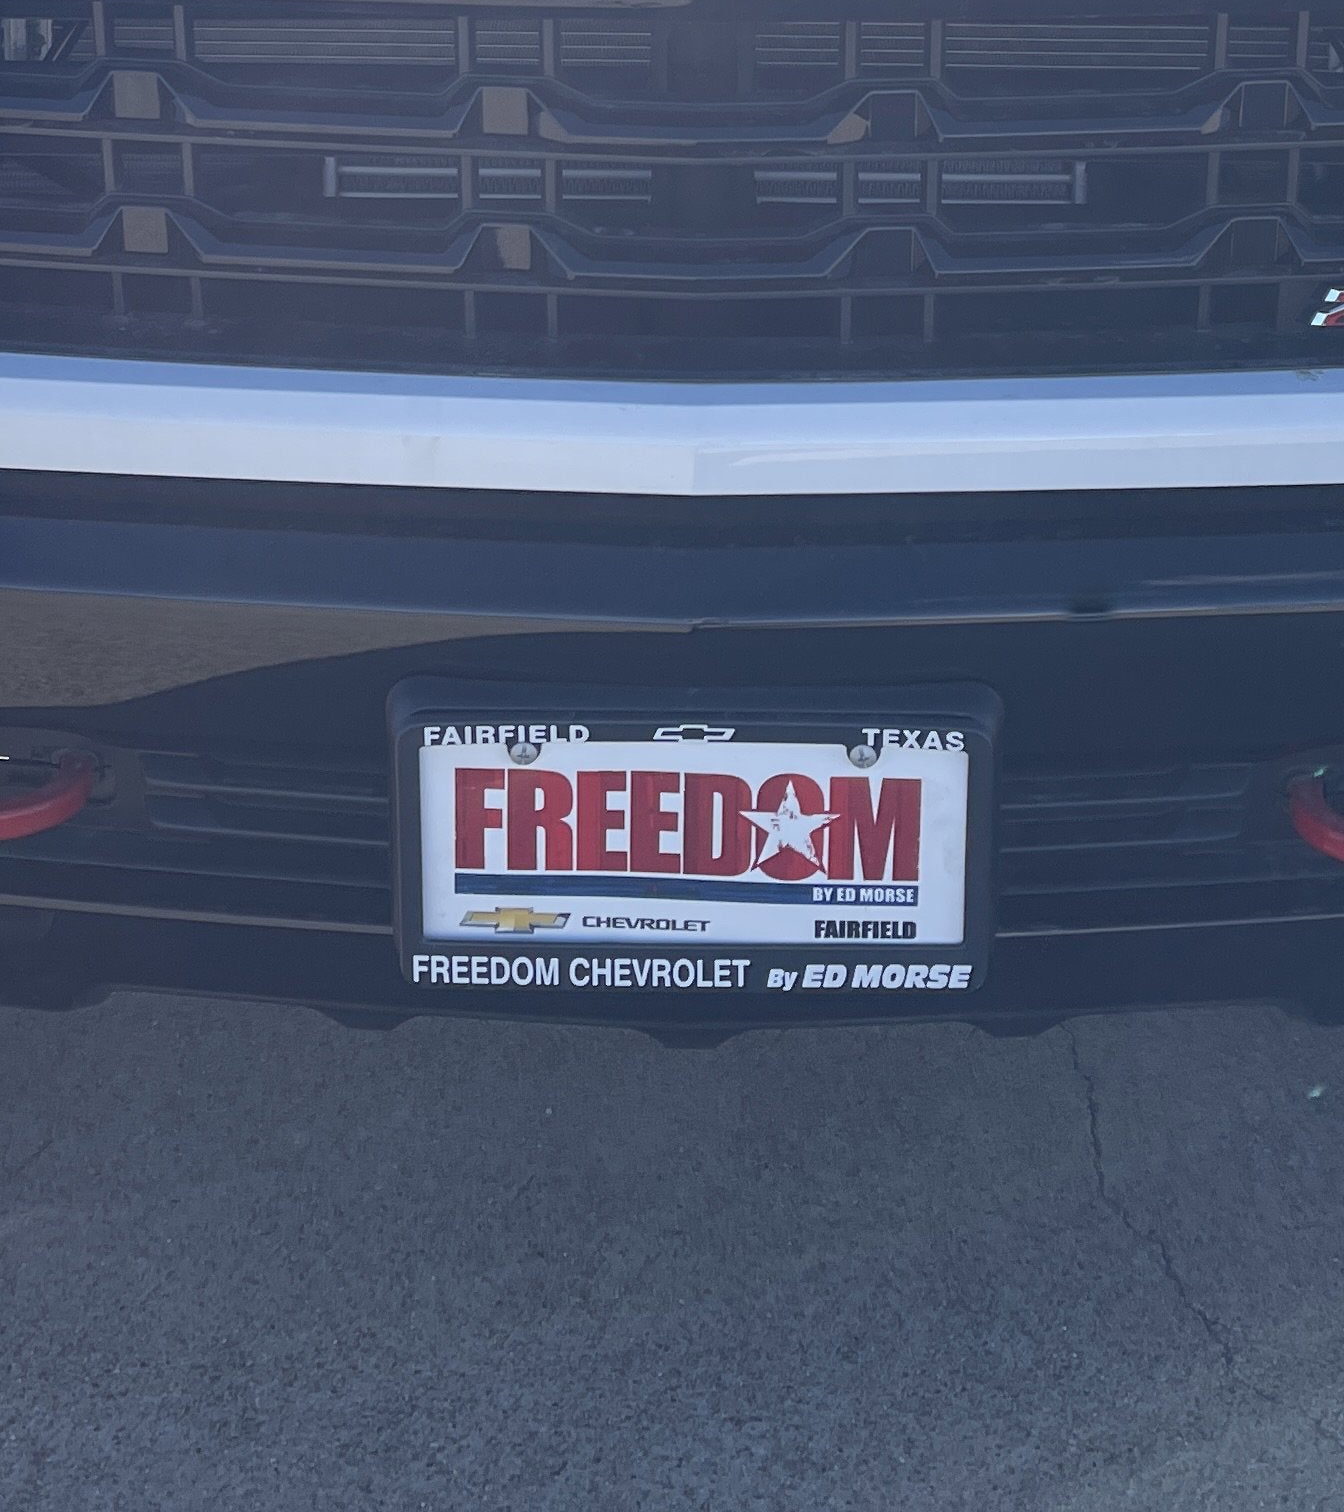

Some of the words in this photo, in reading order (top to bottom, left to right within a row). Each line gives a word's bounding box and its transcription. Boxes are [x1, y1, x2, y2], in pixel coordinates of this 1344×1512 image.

[423, 724, 590, 746] FAIRFIELD
[861, 727, 965, 751] TEXAS
[455, 767, 922, 882] FREEDOM
[812, 886, 833, 902] BY
[836, 887, 856, 902] ED
[859, 888, 914, 903] MORSE
[582, 915, 711, 933] CHEVROLET
[814, 920, 917, 939] FAIRFIELD
[412, 954, 560, 986] FREEDOM
[568, 958, 751, 988] CHEVROLET
[766, 967, 798, 992] By
[801, 963, 848, 989] ED
[851, 963, 973, 990] MORSE
